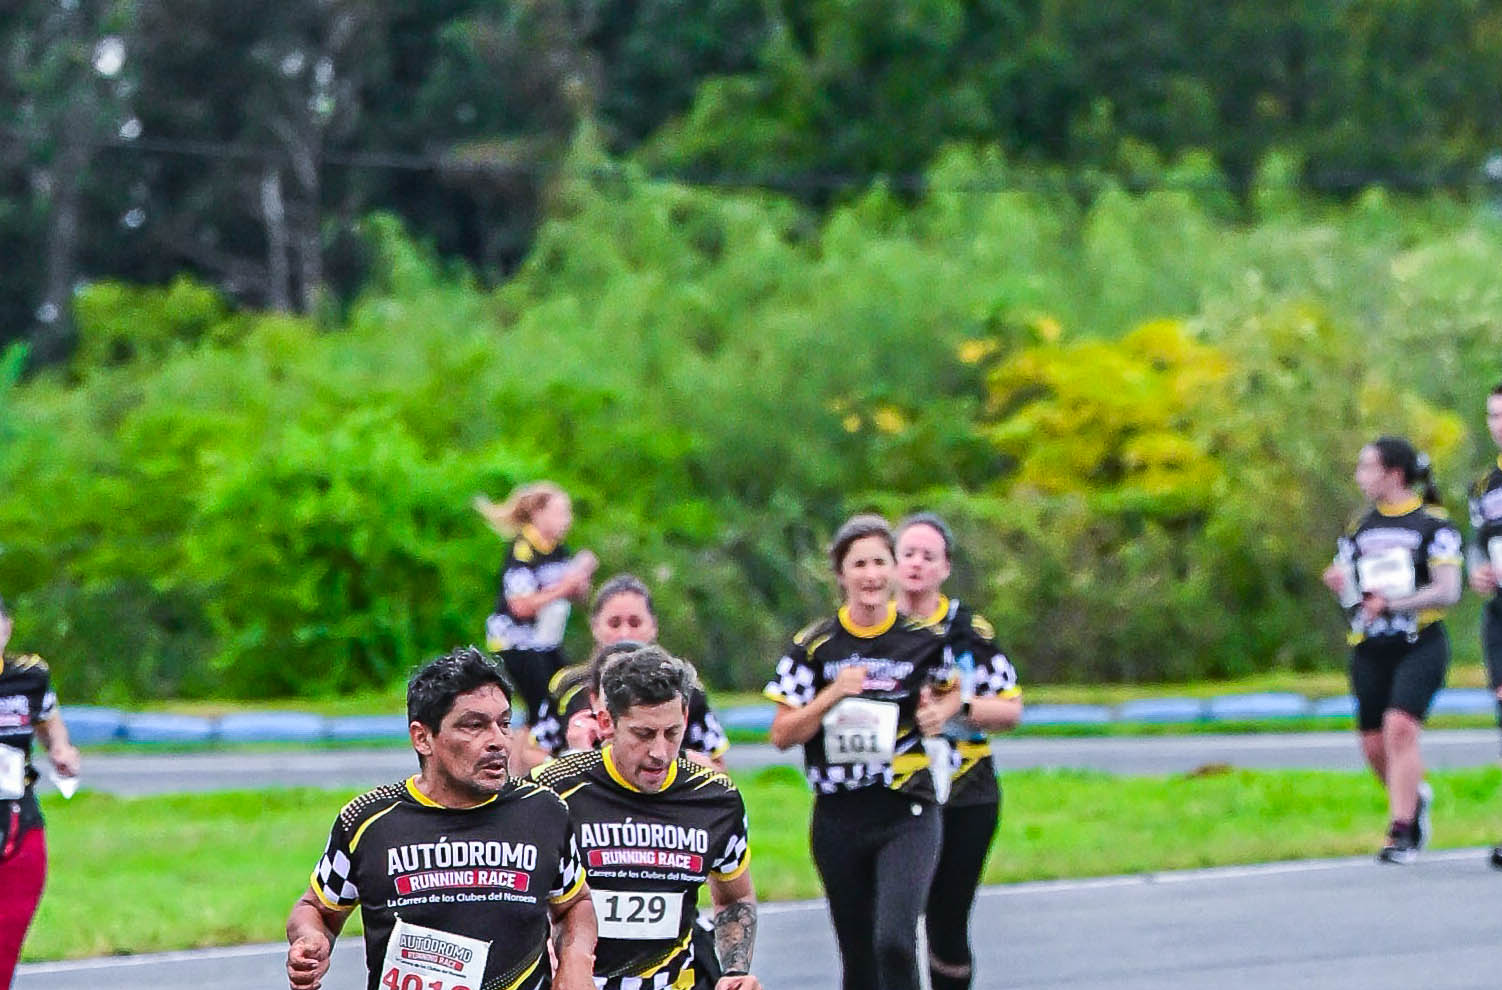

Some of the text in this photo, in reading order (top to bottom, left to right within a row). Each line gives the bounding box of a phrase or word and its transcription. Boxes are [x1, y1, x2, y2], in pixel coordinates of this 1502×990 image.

[838, 734, 881, 753] 101
[581, 816, 709, 854] AUTÓDROMO
[387, 836, 538, 876] AUTÓDROMO
[601, 850, 692, 870] RUNNING RACE
[408, 870, 517, 892] RUNNING RACE
[386, 899, 397, 908] La
[397, 895, 428, 907] Carrera
[428, 894, 440, 904] de
[441, 893, 455, 903] los
[456, 893, 487, 903] Clubes
[487, 892, 503, 901] del
[603, 895, 668, 923] 129
[400, 934, 473, 964] AUTÓDROMO
